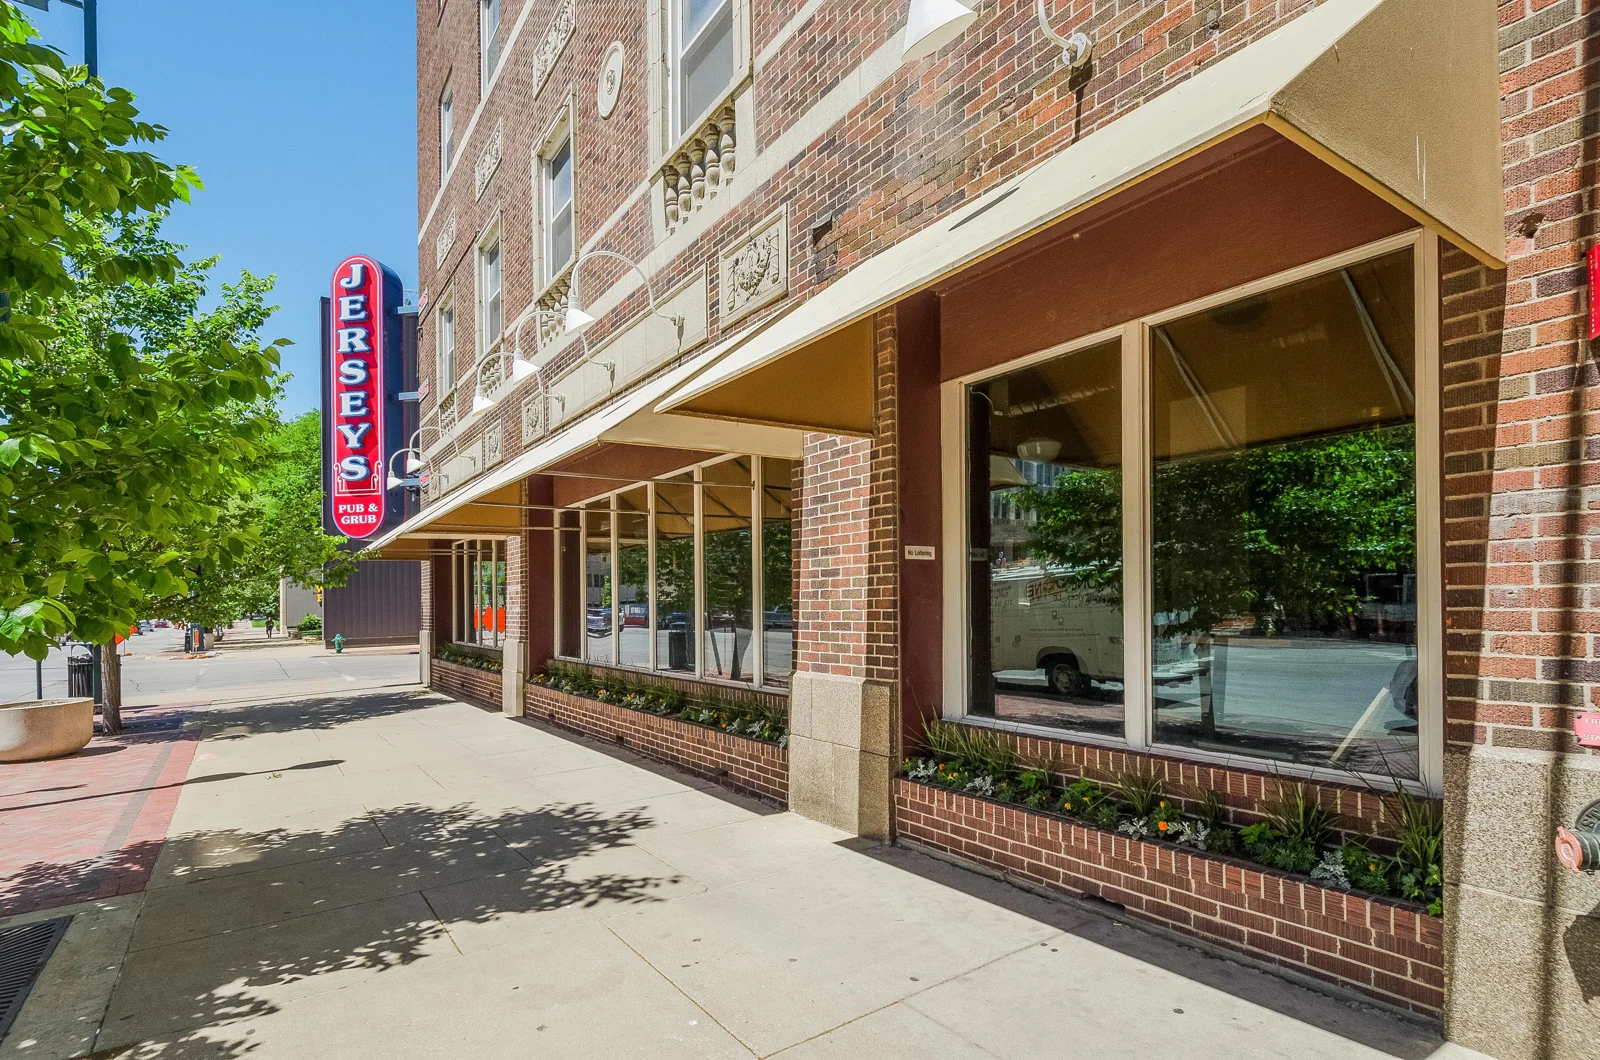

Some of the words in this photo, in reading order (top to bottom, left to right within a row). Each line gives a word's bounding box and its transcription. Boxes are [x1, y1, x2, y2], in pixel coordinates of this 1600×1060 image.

[336, 263, 371, 482] JERSEYS
[338, 503, 365, 514] PUB
[367, 502, 379, 513] &
[340, 514, 377, 525] GRUB
